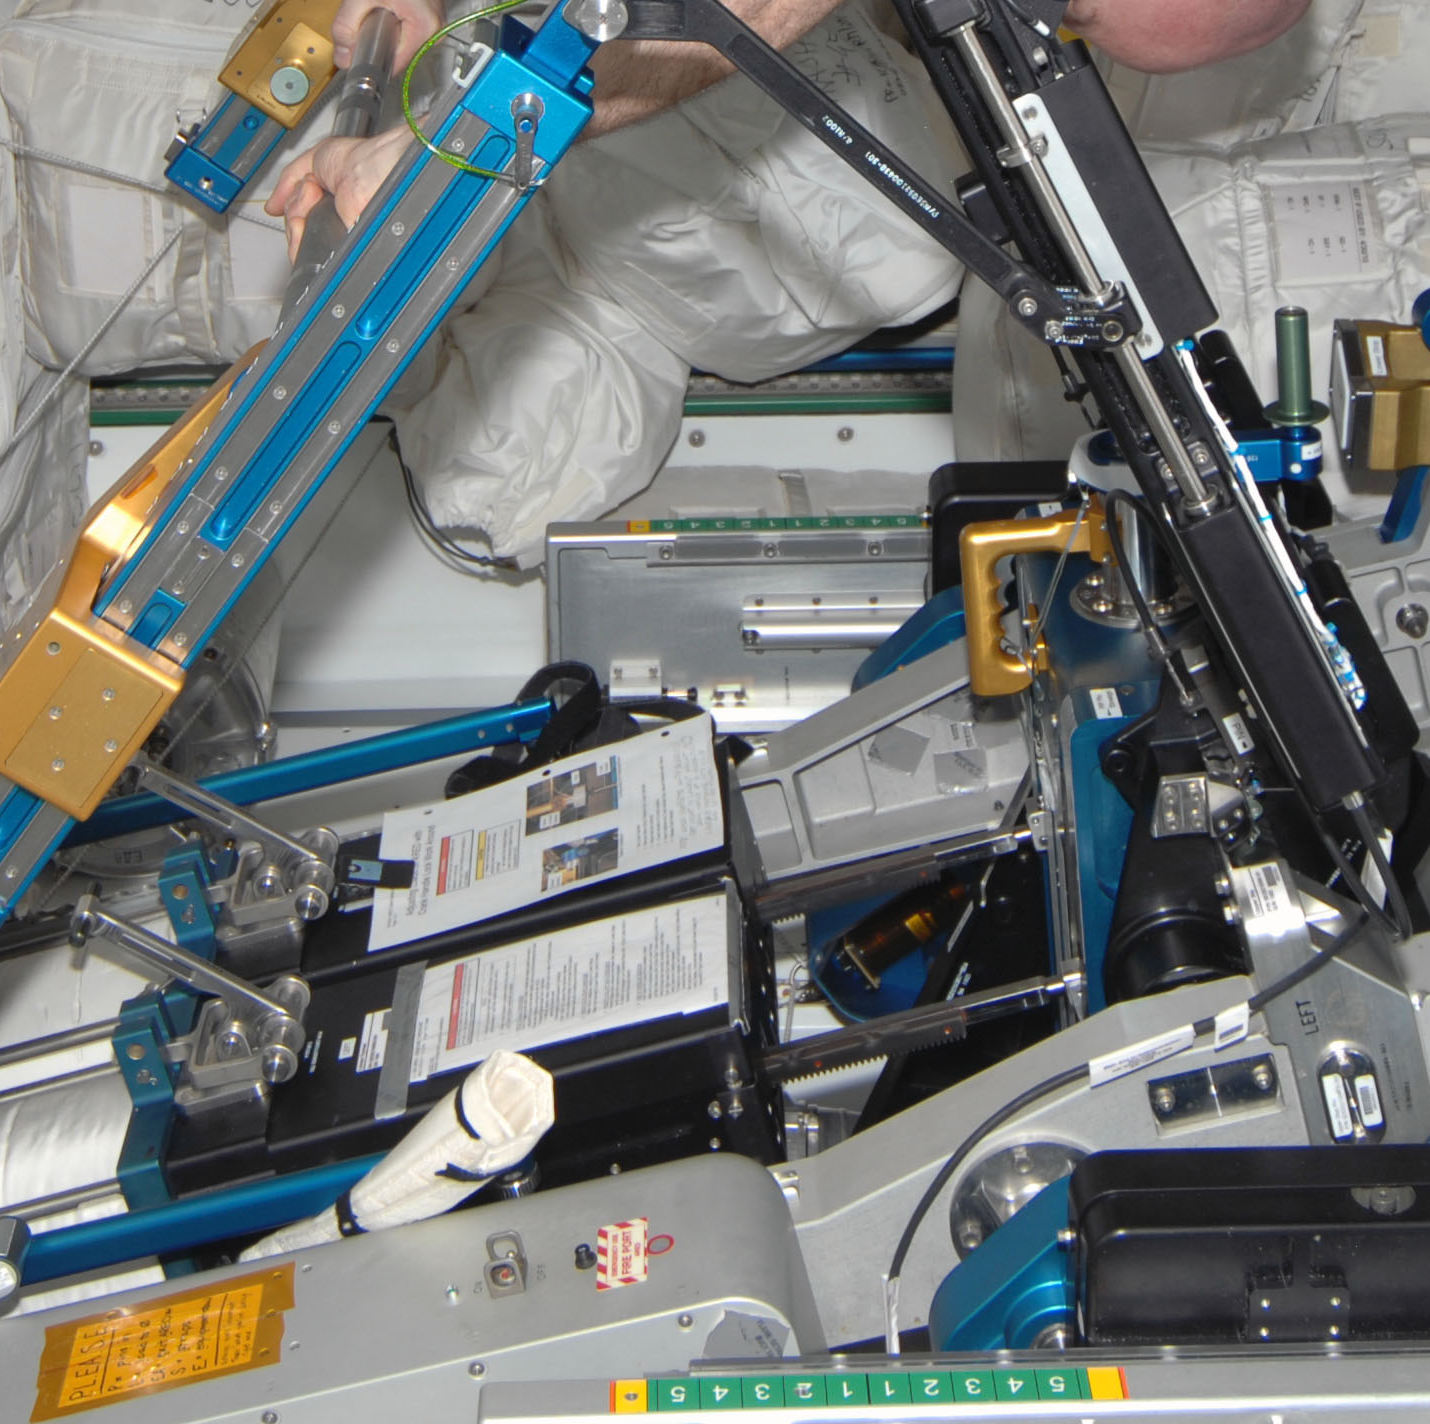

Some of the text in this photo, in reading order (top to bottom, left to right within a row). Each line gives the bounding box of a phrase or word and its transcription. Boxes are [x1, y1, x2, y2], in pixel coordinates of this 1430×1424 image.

[418, 874, 432, 897] Handle
[1295, 998, 1320, 1036] LEFT
[619, 1229, 633, 1275] FIRE PORT
[68, 1322, 110, 1404] PLEASE
[710, 1383, 729, 1402] 4
[753, 1382, 770, 1401] 3
[841, 1380, 853, 1398] 1
[883, 1379, 895, 1397] 1
[921, 1378, 940, 1396] 2
[963, 1376, 981, 1395] 3
[1005, 1375, 1023, 1393] 4
[1048, 1374, 1065, 1392] 5
[668, 1384, 686, 1403] 5
